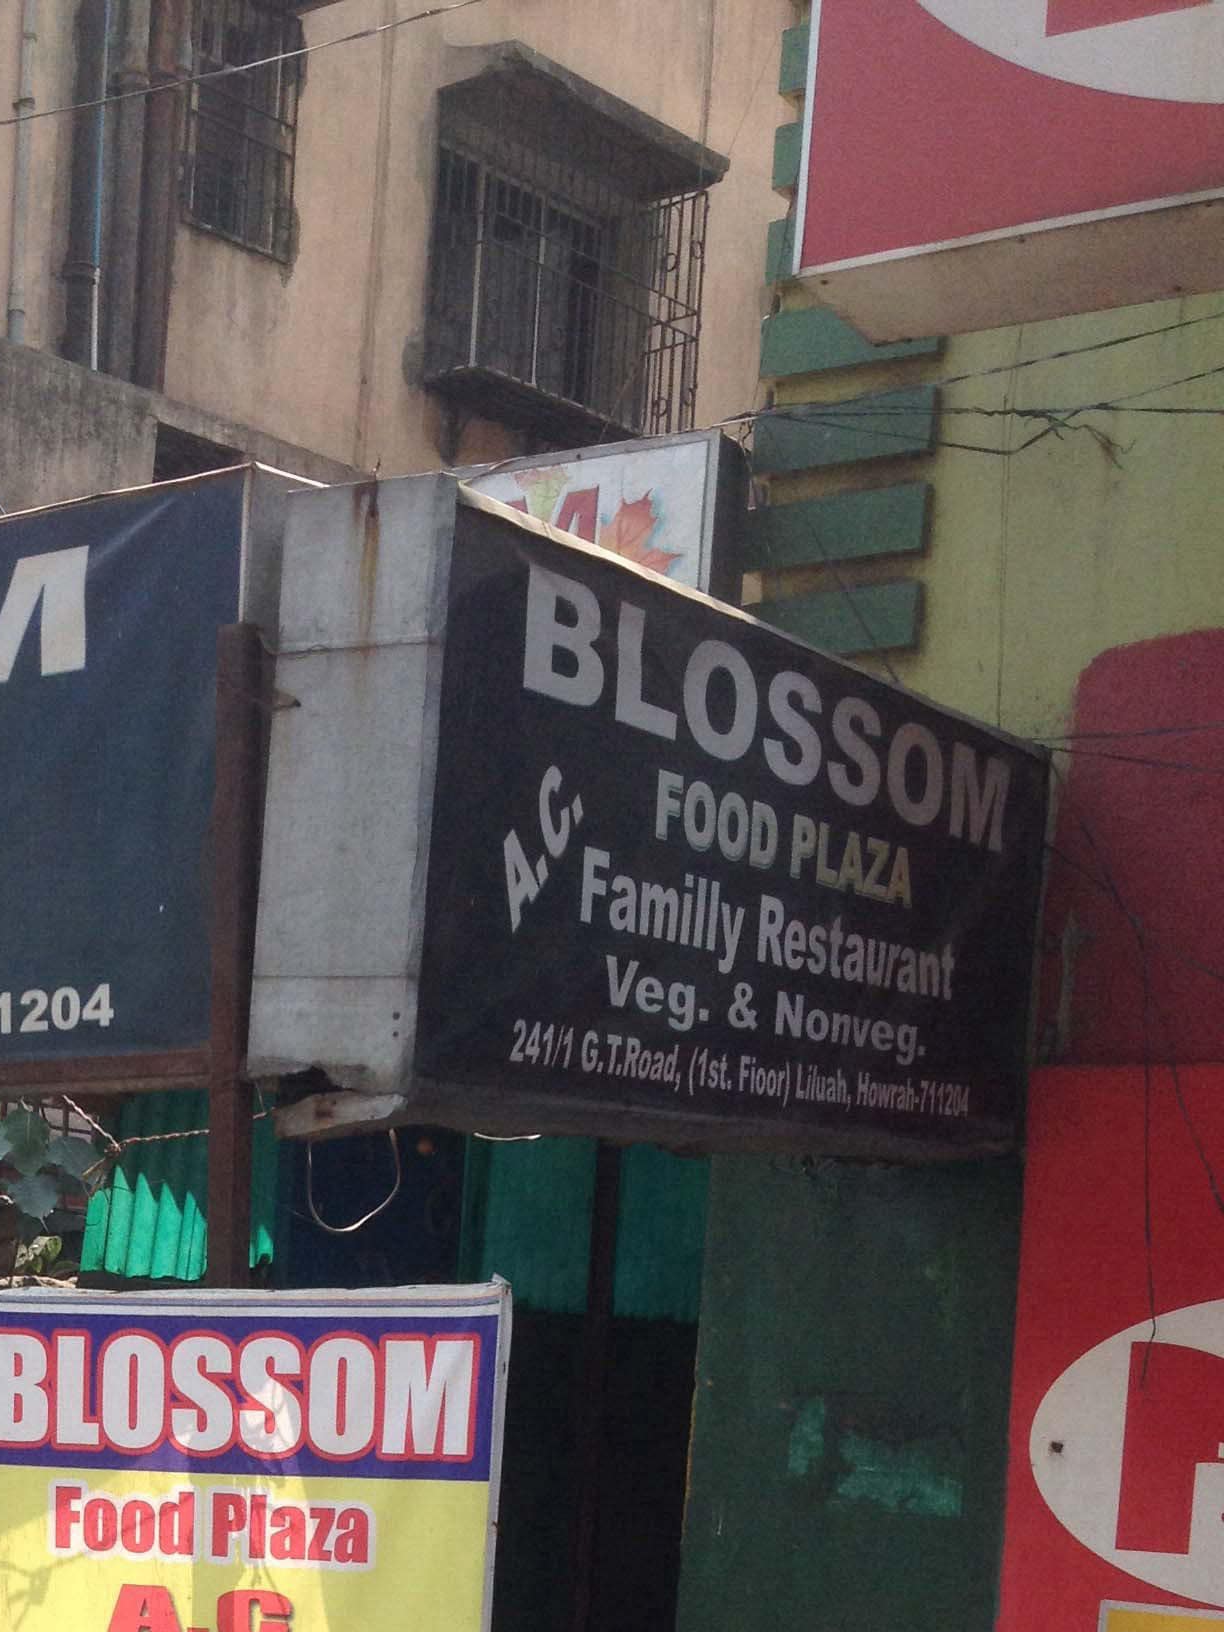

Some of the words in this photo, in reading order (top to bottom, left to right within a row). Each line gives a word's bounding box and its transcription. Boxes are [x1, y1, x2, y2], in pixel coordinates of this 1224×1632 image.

[523, 561, 1012, 854] BLOSSOM
[654, 768, 778, 871] FOOD
[791, 814, 913, 908] PLAZA
[579, 845, 745, 975] Familly
[757, 893, 955, 1001] Restaurant
[509, 1019, 574, 1072] 241/1
[856, 1071, 970, 1118] Howrah-711204
[605, 954, 710, 1032] Veg.
[726, 981, 760, 1031] &
[774, 990, 928, 1066] Nonveg.
[54, 1486, 194, 1555] Food
[211, 1490, 370, 1564] Plaza
